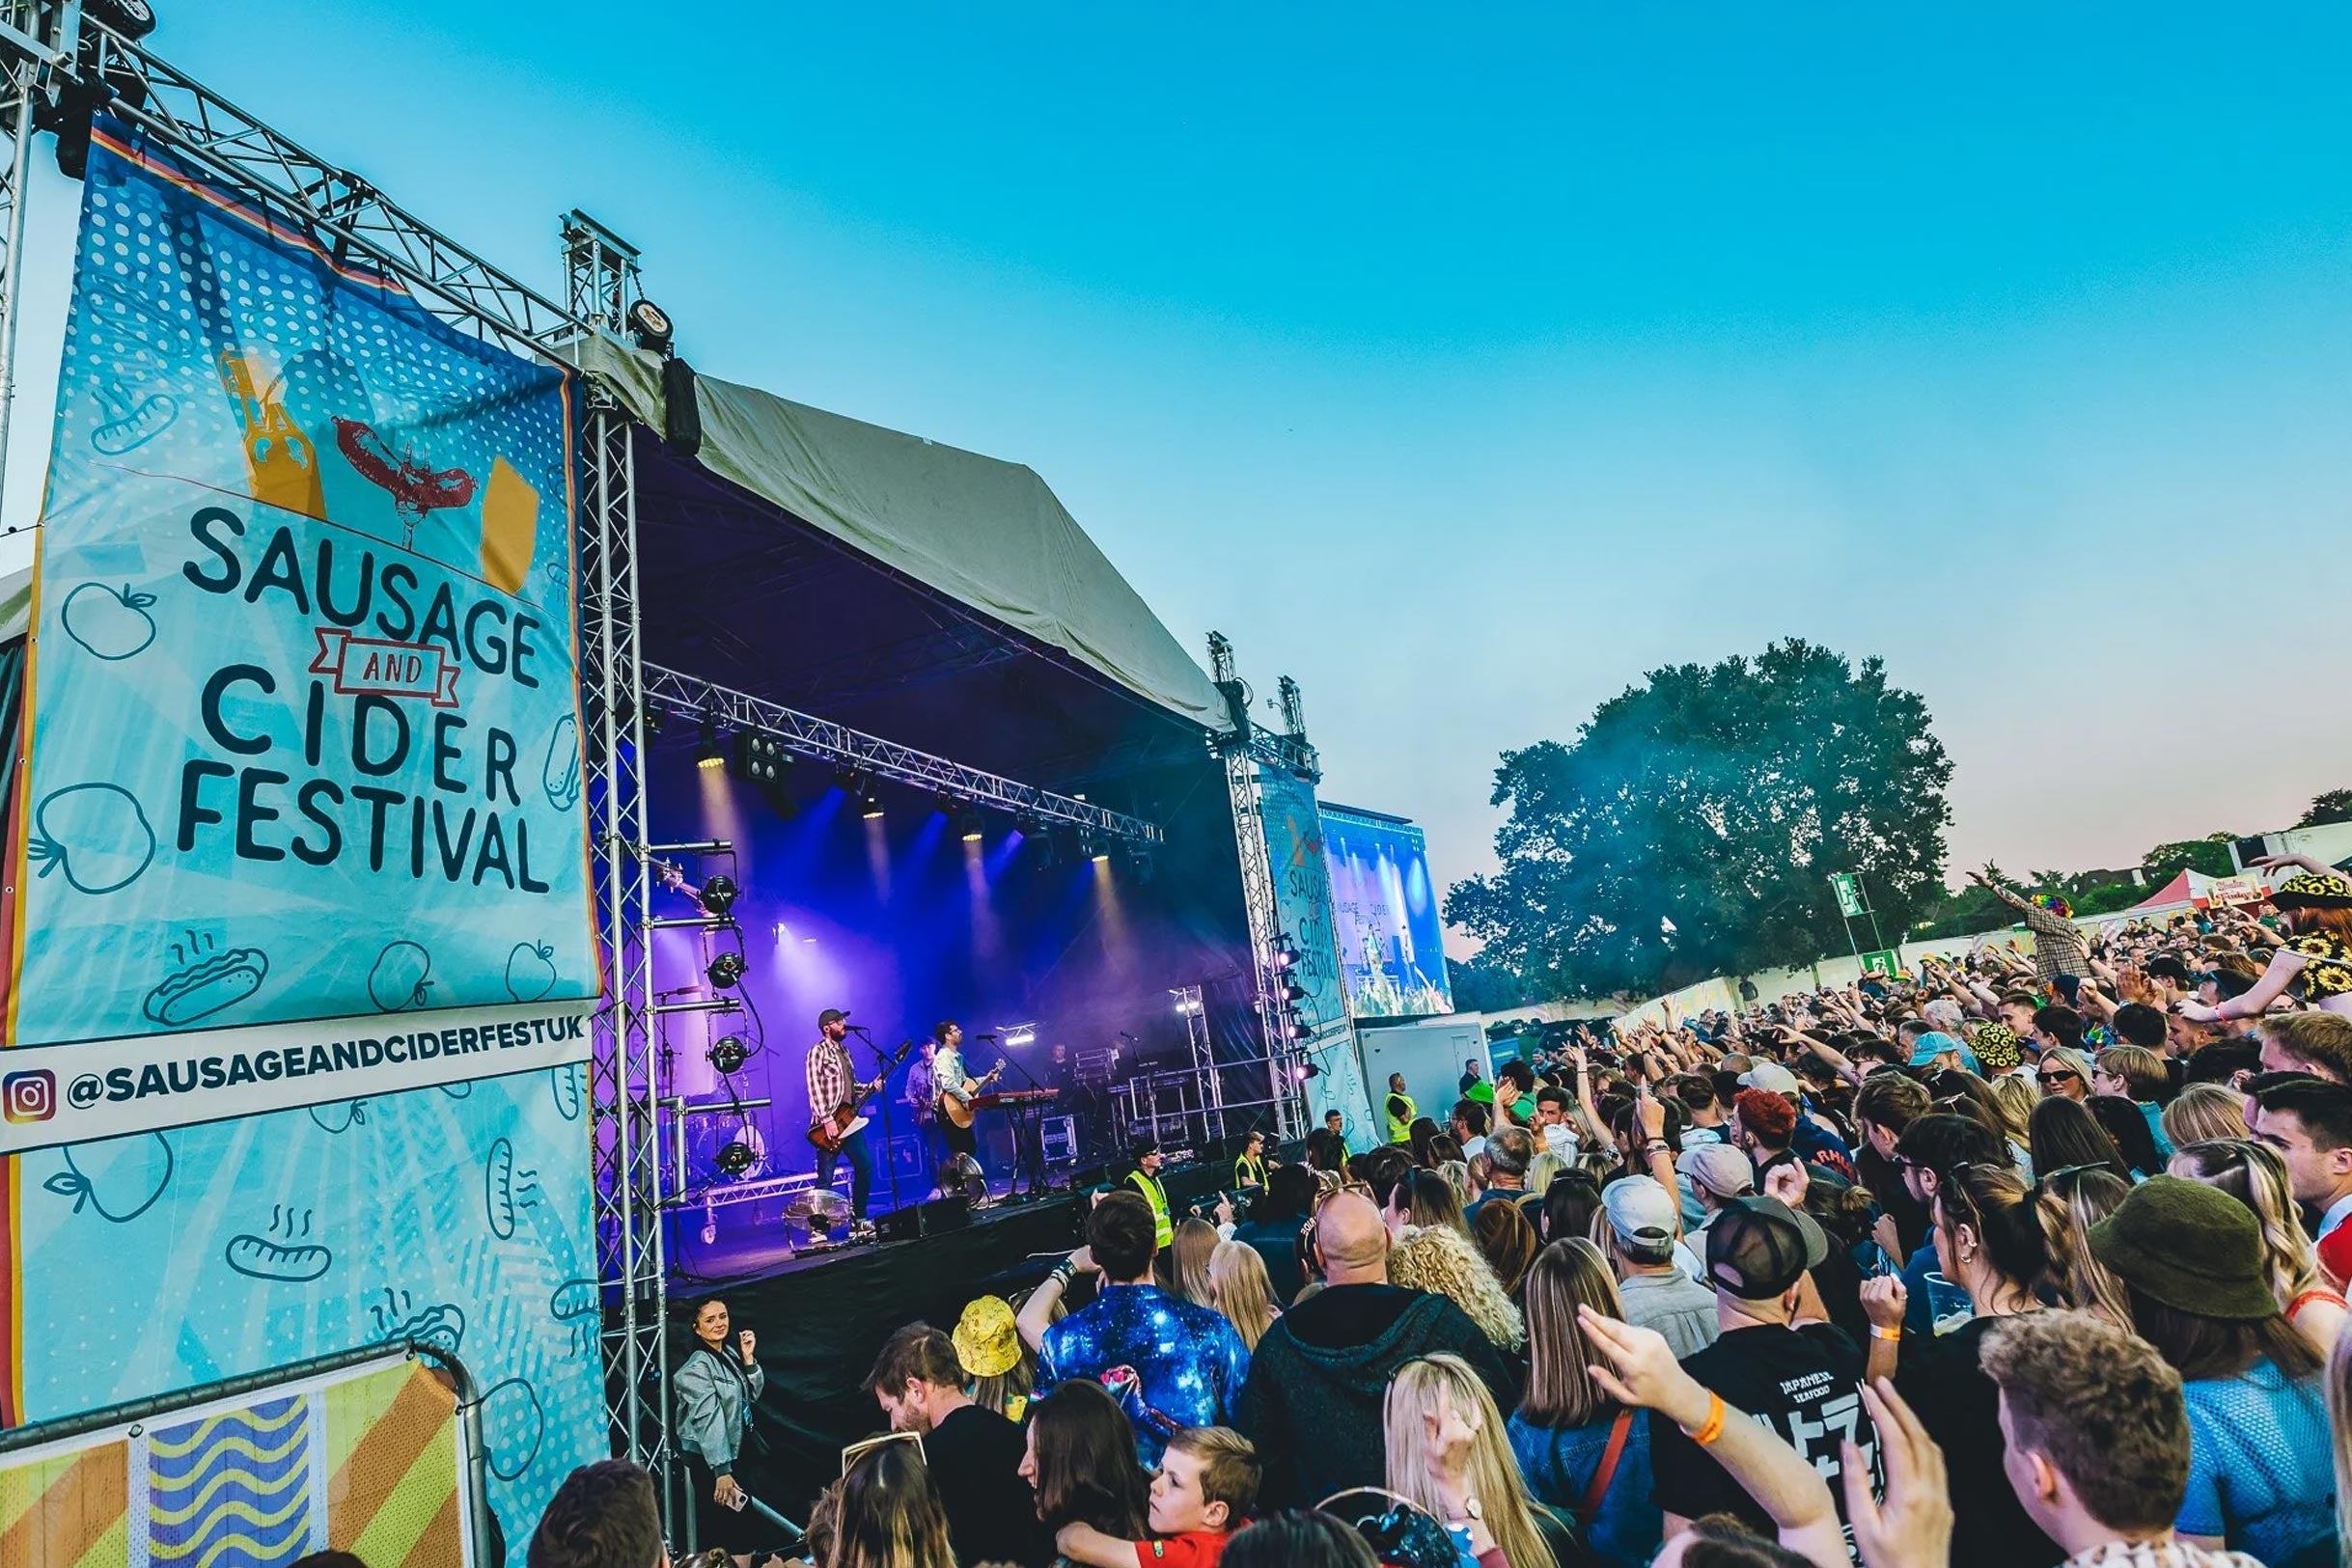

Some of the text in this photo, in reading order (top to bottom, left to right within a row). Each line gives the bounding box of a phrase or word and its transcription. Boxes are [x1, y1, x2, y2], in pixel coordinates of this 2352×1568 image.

[182, 507, 542, 688] SAUSAGE
[364, 650, 423, 684] AND
[201, 663, 521, 806] CIDER
[177, 759, 550, 894] FESTIVAL
[67, 1015, 585, 1110] @SAUSAGEANDCIDERFESTUK
[1779, 1371, 1834, 1395] JAPANESE
[1793, 1384, 1831, 1404] SEAFOOD
